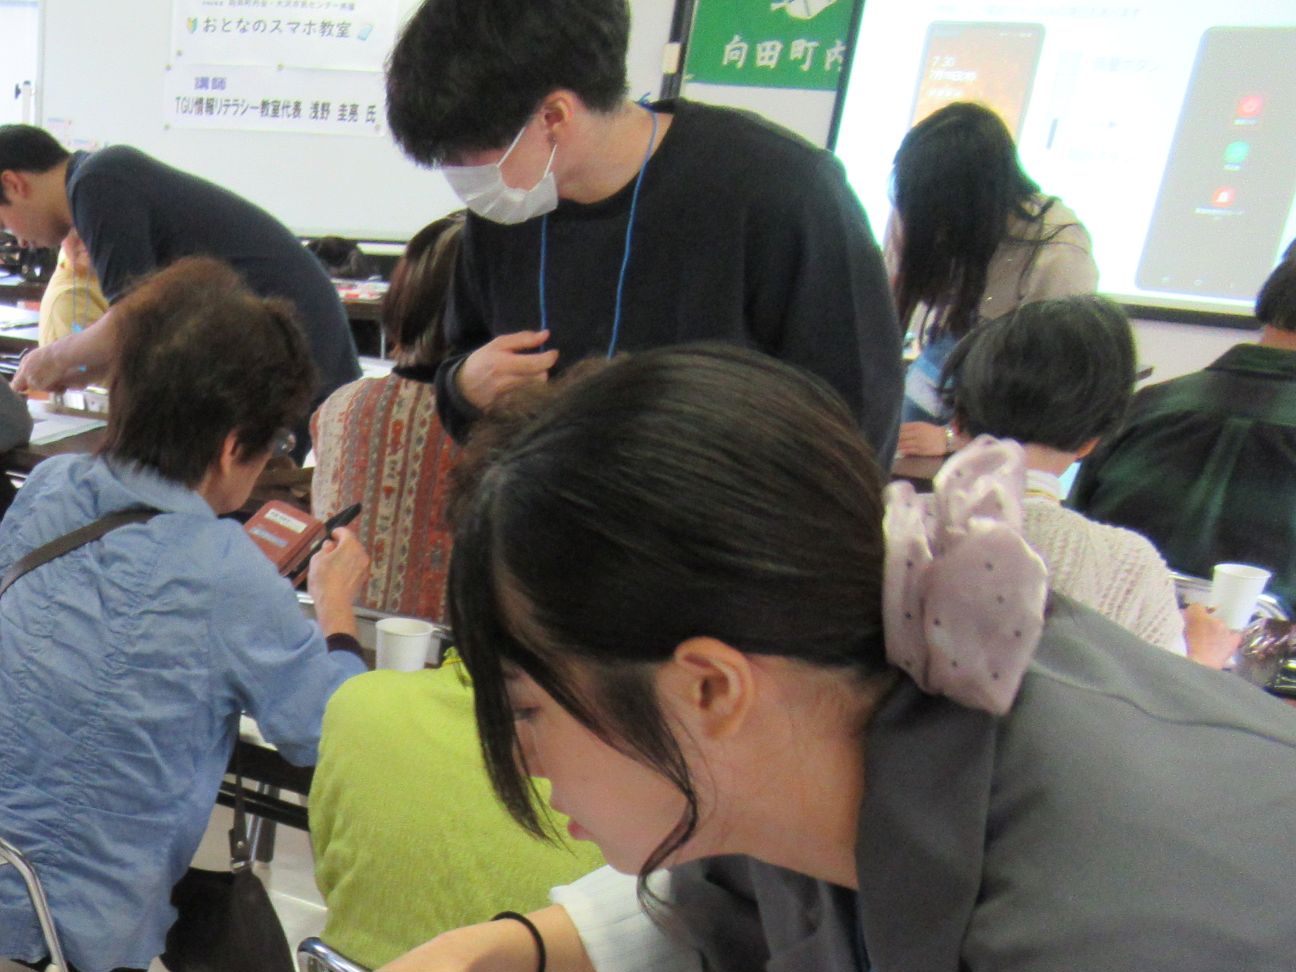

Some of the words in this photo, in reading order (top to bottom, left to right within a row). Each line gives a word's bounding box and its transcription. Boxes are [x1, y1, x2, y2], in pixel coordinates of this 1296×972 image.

[203, 17, 352, 38] おとなのスマホ教室
[722, 34, 846, 71] 向田町内
[366, 104, 377, 123] 氏
